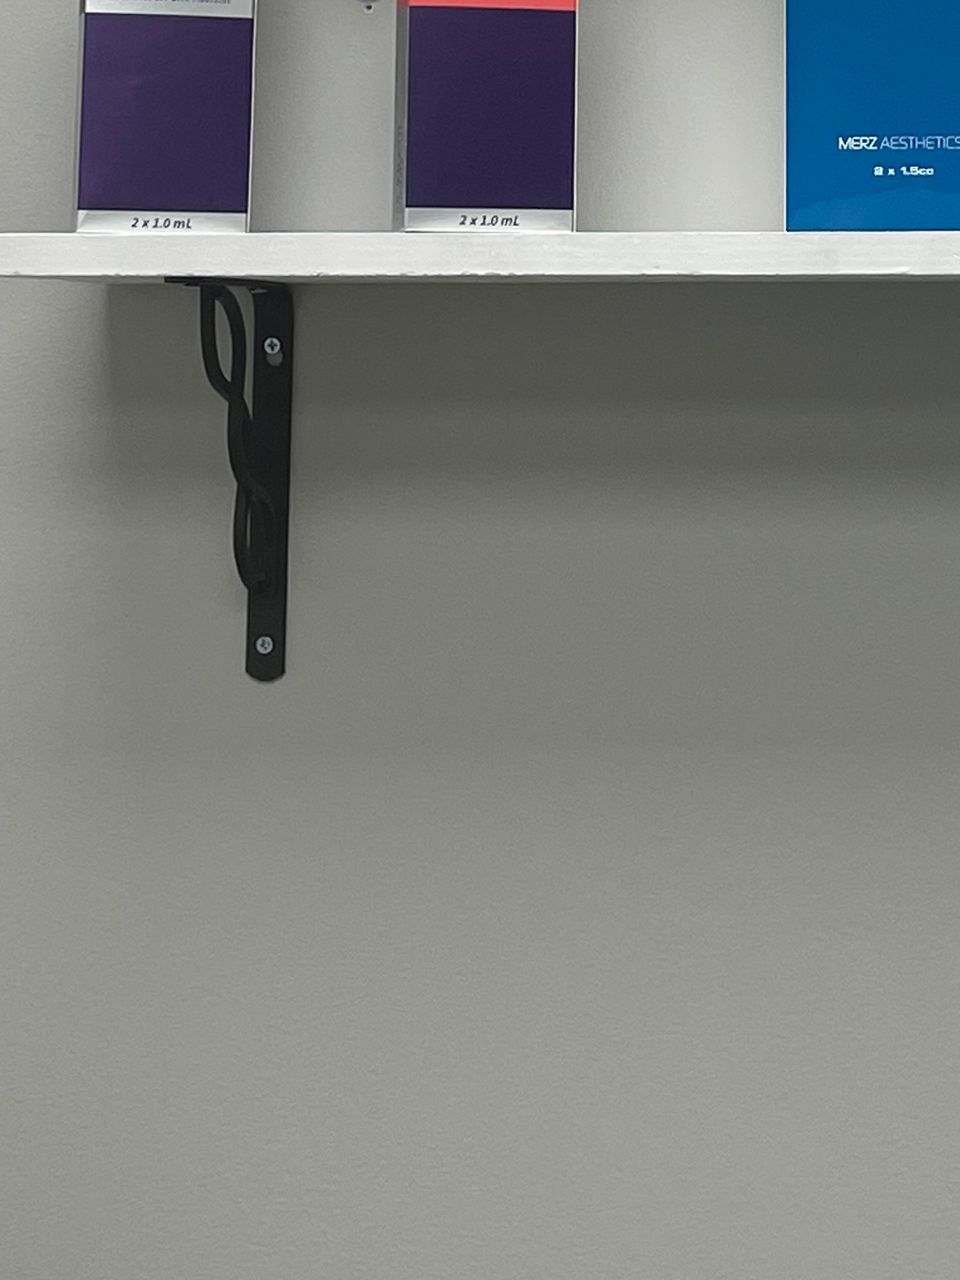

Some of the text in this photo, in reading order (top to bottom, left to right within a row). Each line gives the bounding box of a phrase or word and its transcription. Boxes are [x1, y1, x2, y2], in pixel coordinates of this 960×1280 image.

[838, 136, 878, 150] MERZ
[873, 166, 935, 176] 2 x 1.5cc
[131, 217, 192, 230] 2 x 1.0 mL
[459, 215, 520, 226] 2 x 1.0 mL
